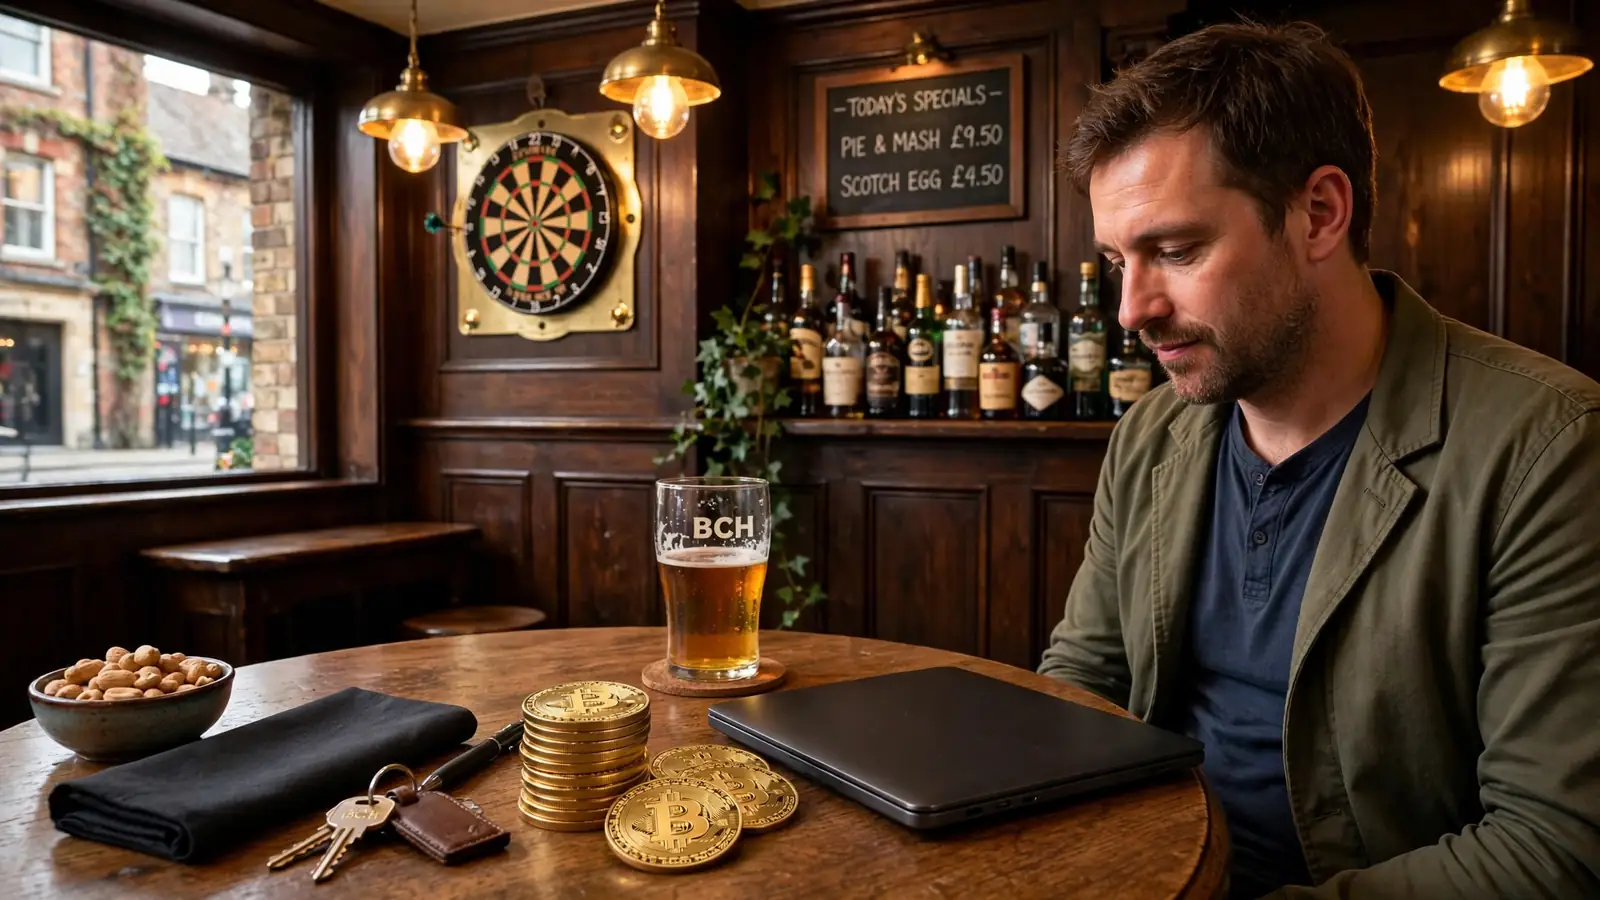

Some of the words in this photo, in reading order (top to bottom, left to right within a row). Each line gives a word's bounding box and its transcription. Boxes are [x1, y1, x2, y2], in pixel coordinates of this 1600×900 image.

[847, 90, 907, 117] TODAY'S
[913, 85, 986, 112] SPECIALS
[841, 136, 866, 159] PIE
[874, 134, 886, 155] &
[893, 129, 940, 153] MASH
[950, 124, 1003, 149] £9.50
[840, 172, 900, 198] SCOTCH
[908, 169, 942, 192] EGG
[950, 164, 1004, 189] £4.50
[693, 516, 754, 539] BCH
